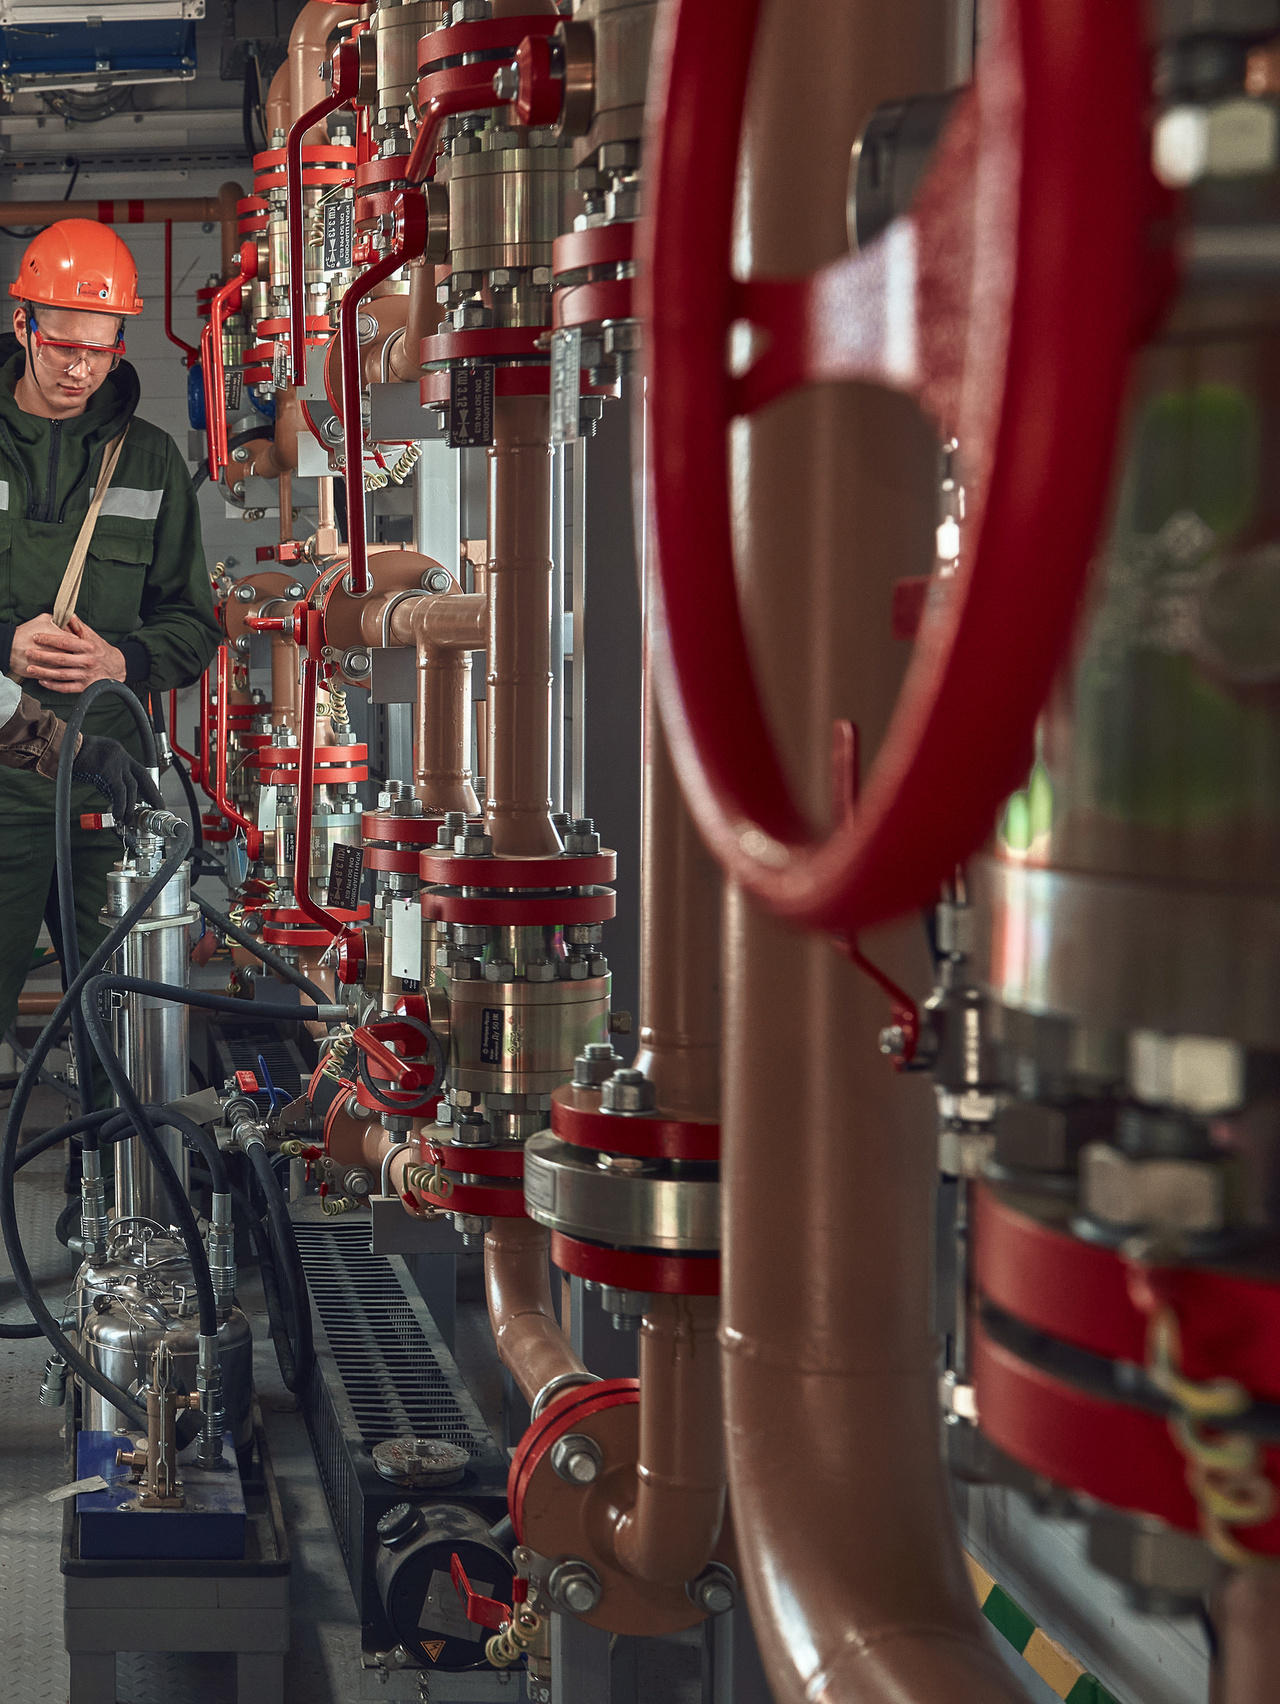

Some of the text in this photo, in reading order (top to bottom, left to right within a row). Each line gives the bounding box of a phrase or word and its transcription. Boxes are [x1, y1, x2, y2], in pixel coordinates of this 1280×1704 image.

[328, 207, 336, 238] КШ 3.13
[339, 213, 345, 224] DN
[339, 225, 345, 235] 50
[339, 236, 345, 247] PN
[457, 370, 468, 407] КШ 3.12
[475, 379, 482, 433] DN 50 PN 63
[482, 396, 490, 441] ШАРОВОЙ
[335, 847, 346, 876] КШ 3.8
[348, 857, 354, 868] DN
[348, 869, 353, 878] 50
[346, 879, 352, 890] PN
[350, 872, 359, 907] ШАРОВОЙ
